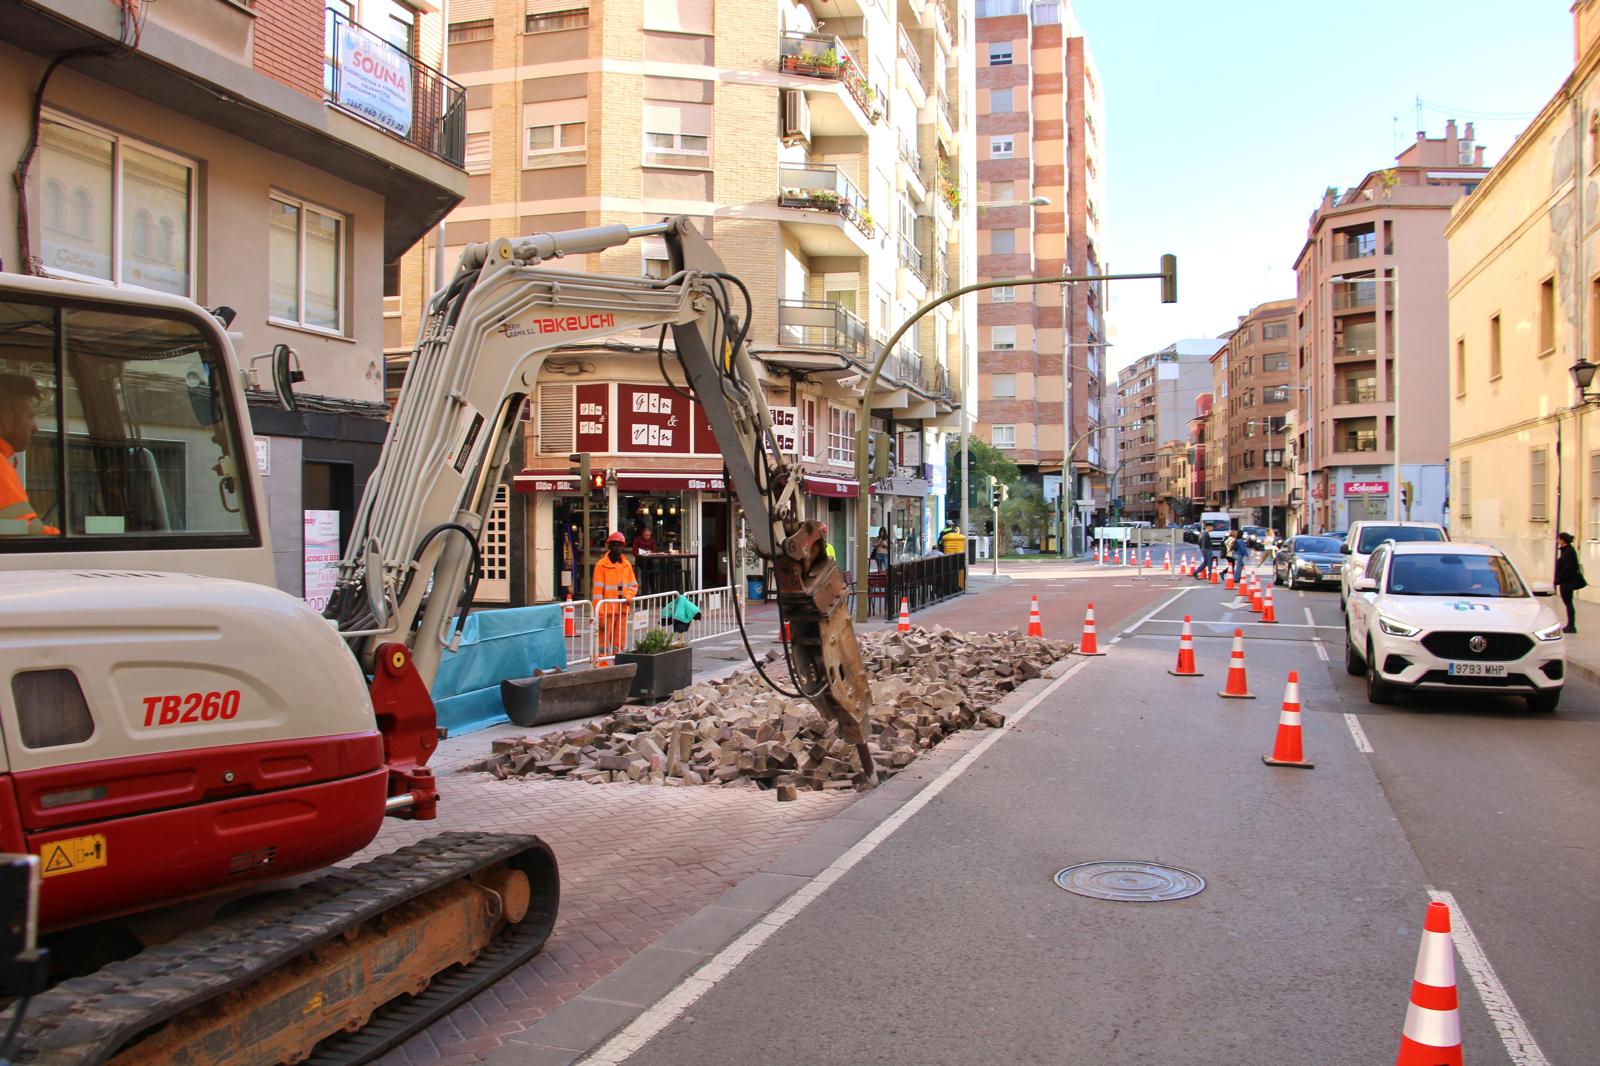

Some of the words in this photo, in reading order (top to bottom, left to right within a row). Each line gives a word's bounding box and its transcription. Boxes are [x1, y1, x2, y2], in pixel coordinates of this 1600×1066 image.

[353, 50, 406, 92] SOUNA
[533, 313, 615, 335] TAKEUCHI
[634, 393, 671, 413] Gin
[667, 414, 679, 427] &
[633, 426, 672, 443] Vin
[1455, 664, 1482, 675] 9793
[1484, 665, 1505, 675] MHP
[142, 689, 241, 727] TB260
